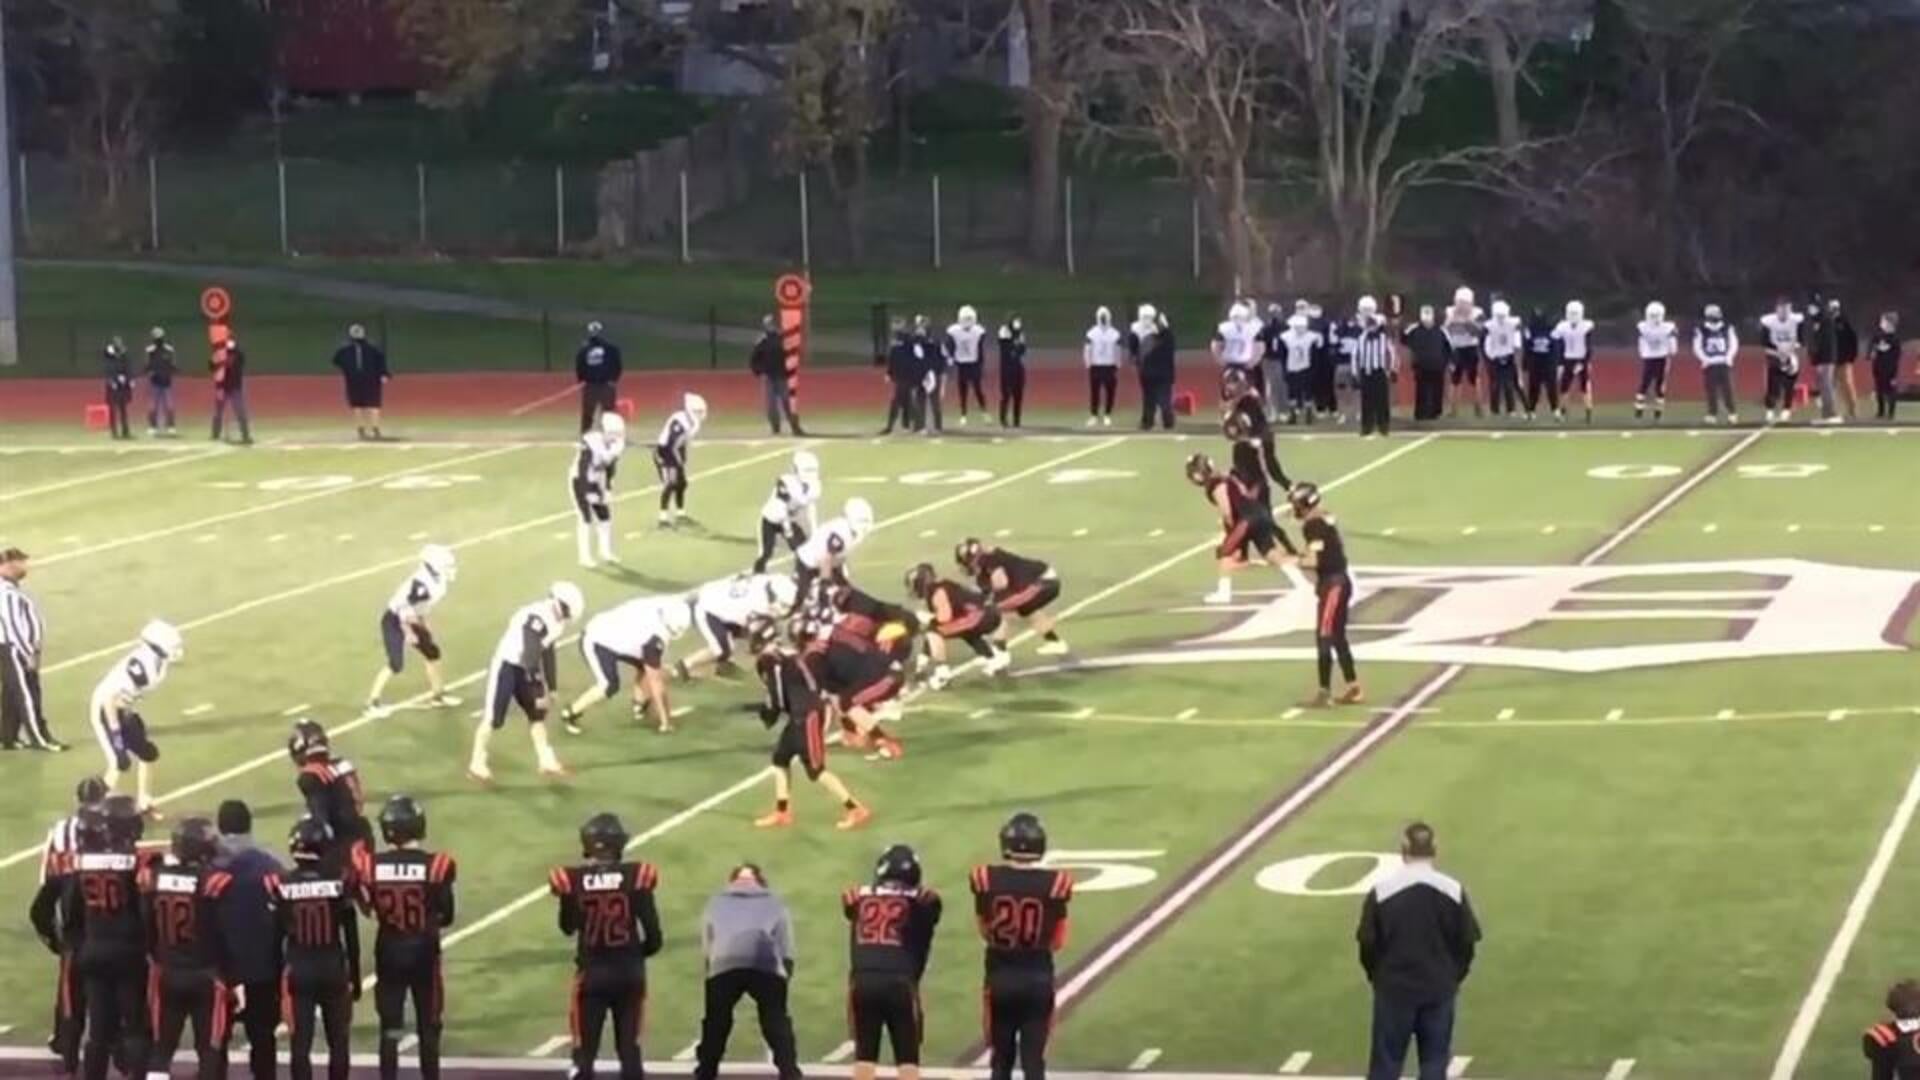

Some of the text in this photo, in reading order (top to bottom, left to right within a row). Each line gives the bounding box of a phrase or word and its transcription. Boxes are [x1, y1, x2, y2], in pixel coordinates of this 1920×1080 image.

[582, 872, 624, 890] CAMP
[579, 894, 631, 946] 72
[857, 897, 909, 946] 22
[993, 896, 1044, 950] 20
